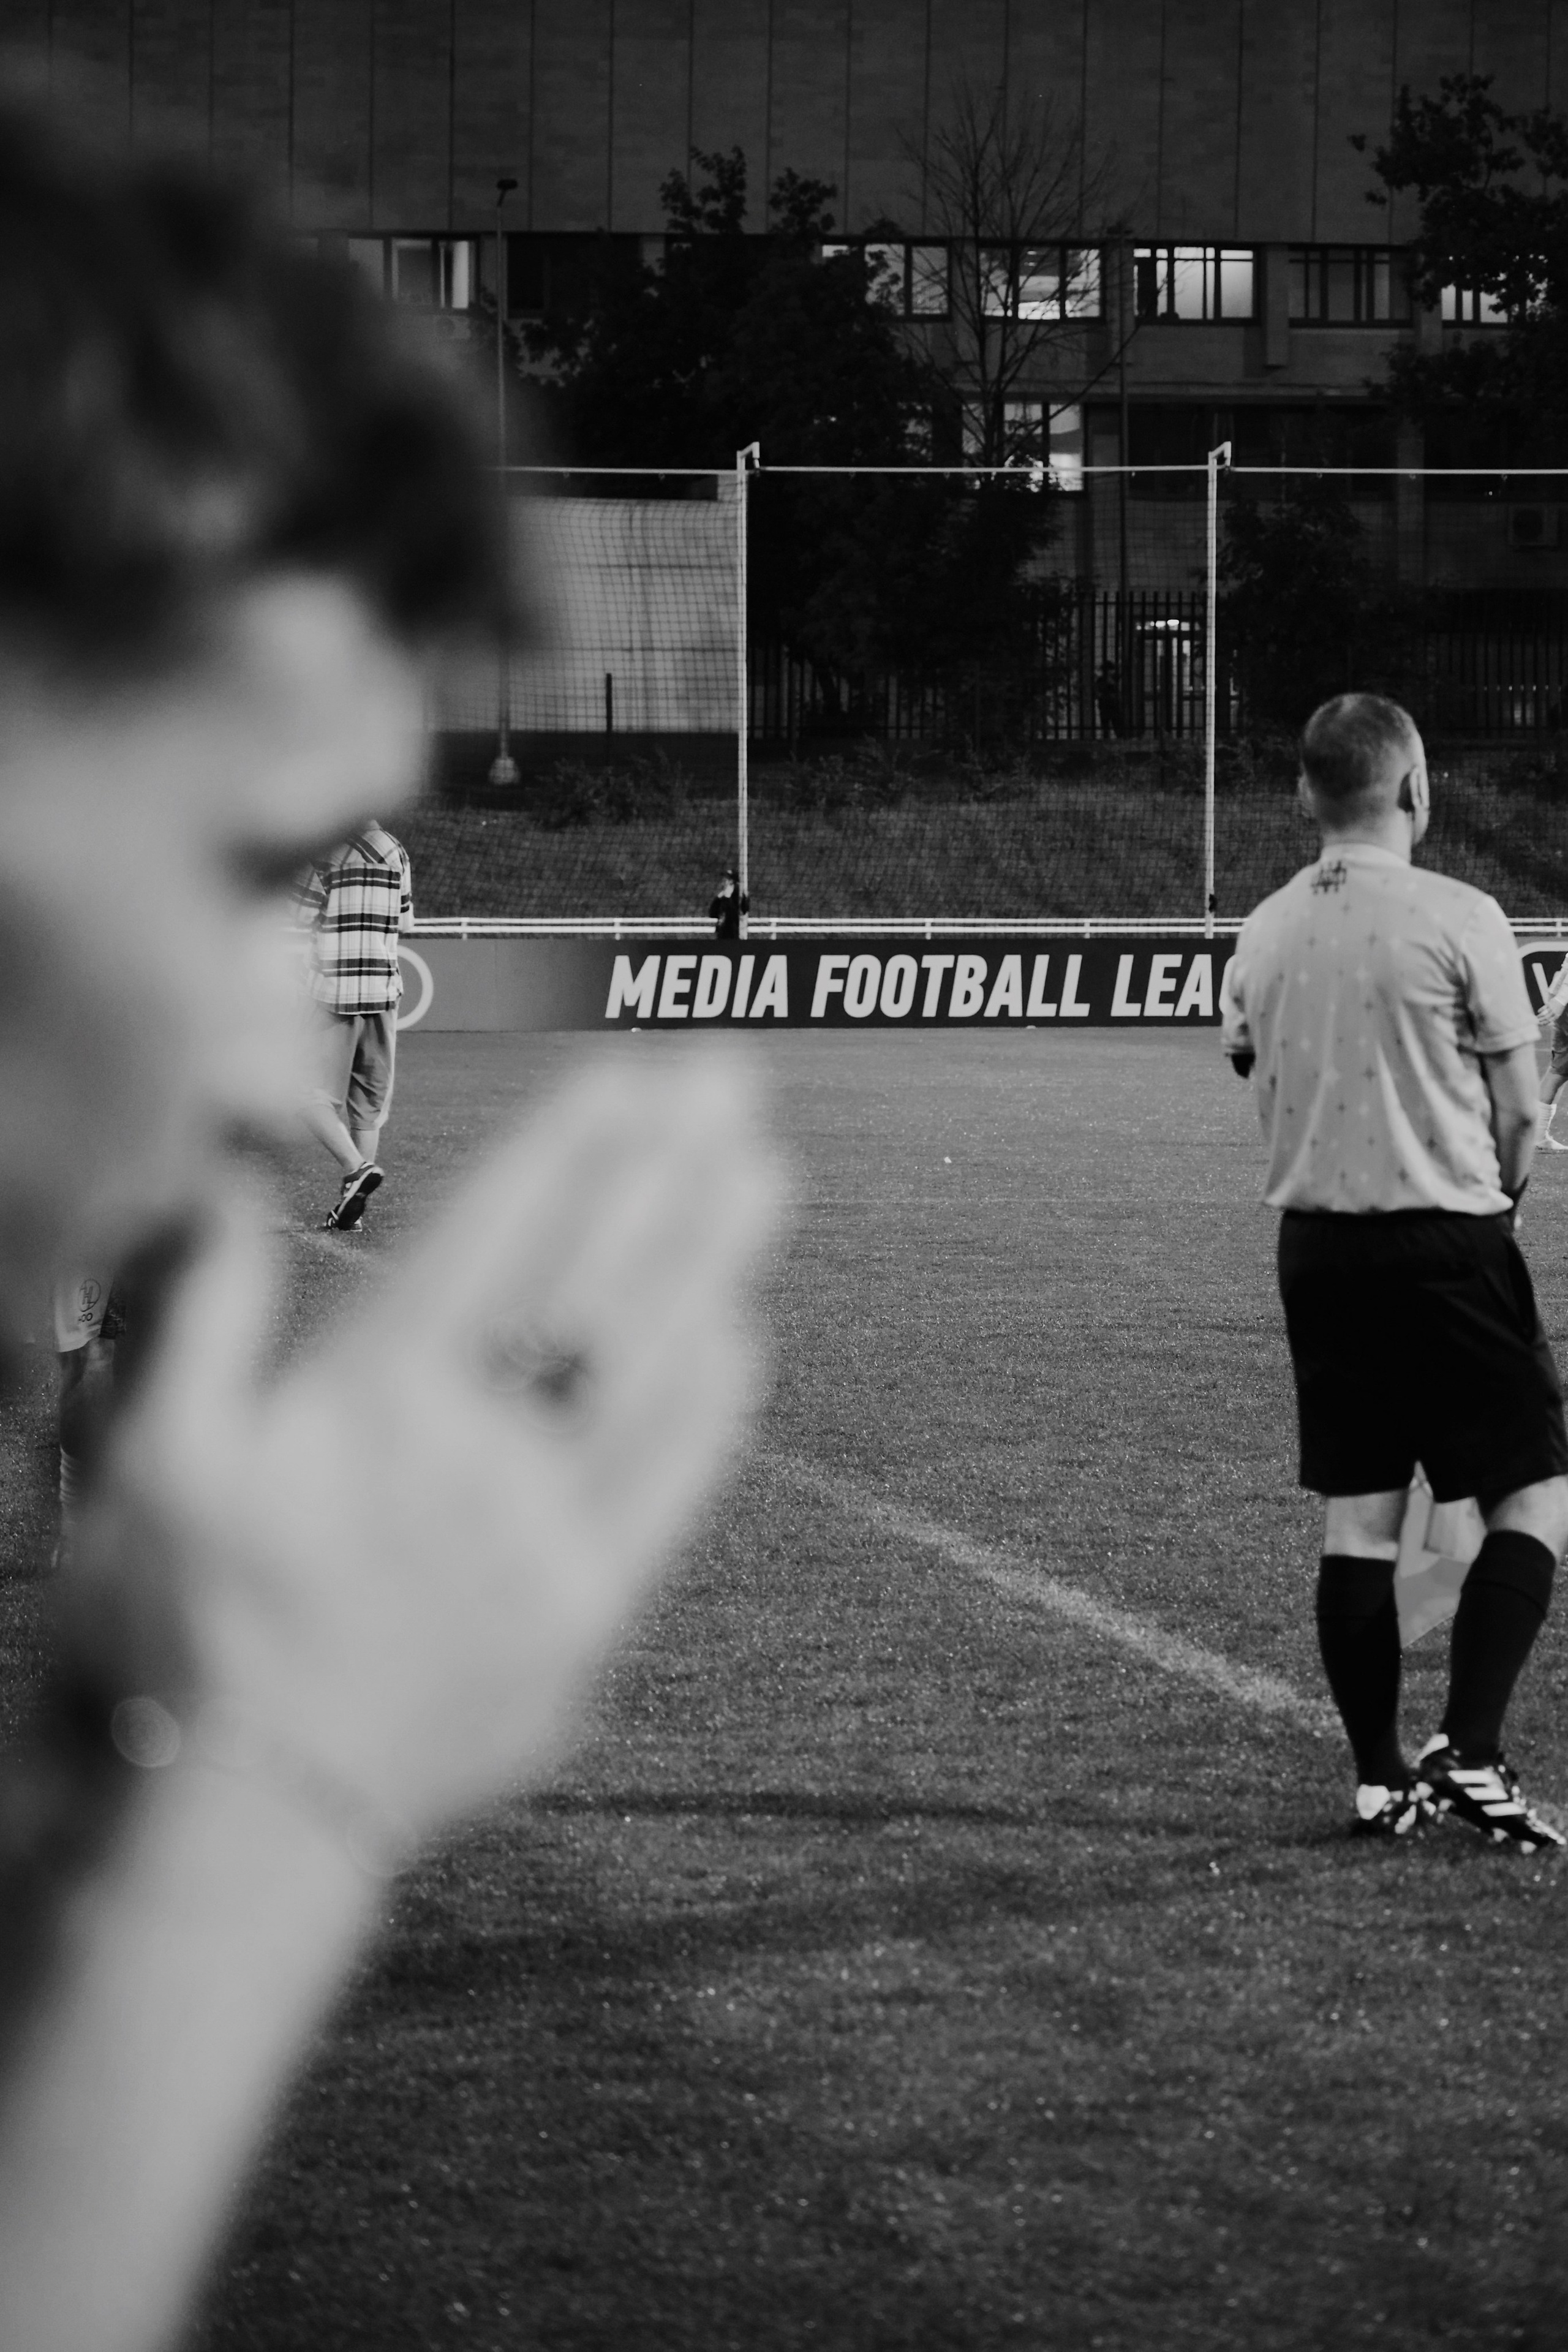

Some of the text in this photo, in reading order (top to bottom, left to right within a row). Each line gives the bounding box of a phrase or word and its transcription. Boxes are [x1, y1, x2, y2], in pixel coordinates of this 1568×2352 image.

[605, 954, 1230, 1018] MEDIA FOOTBALL LEA
